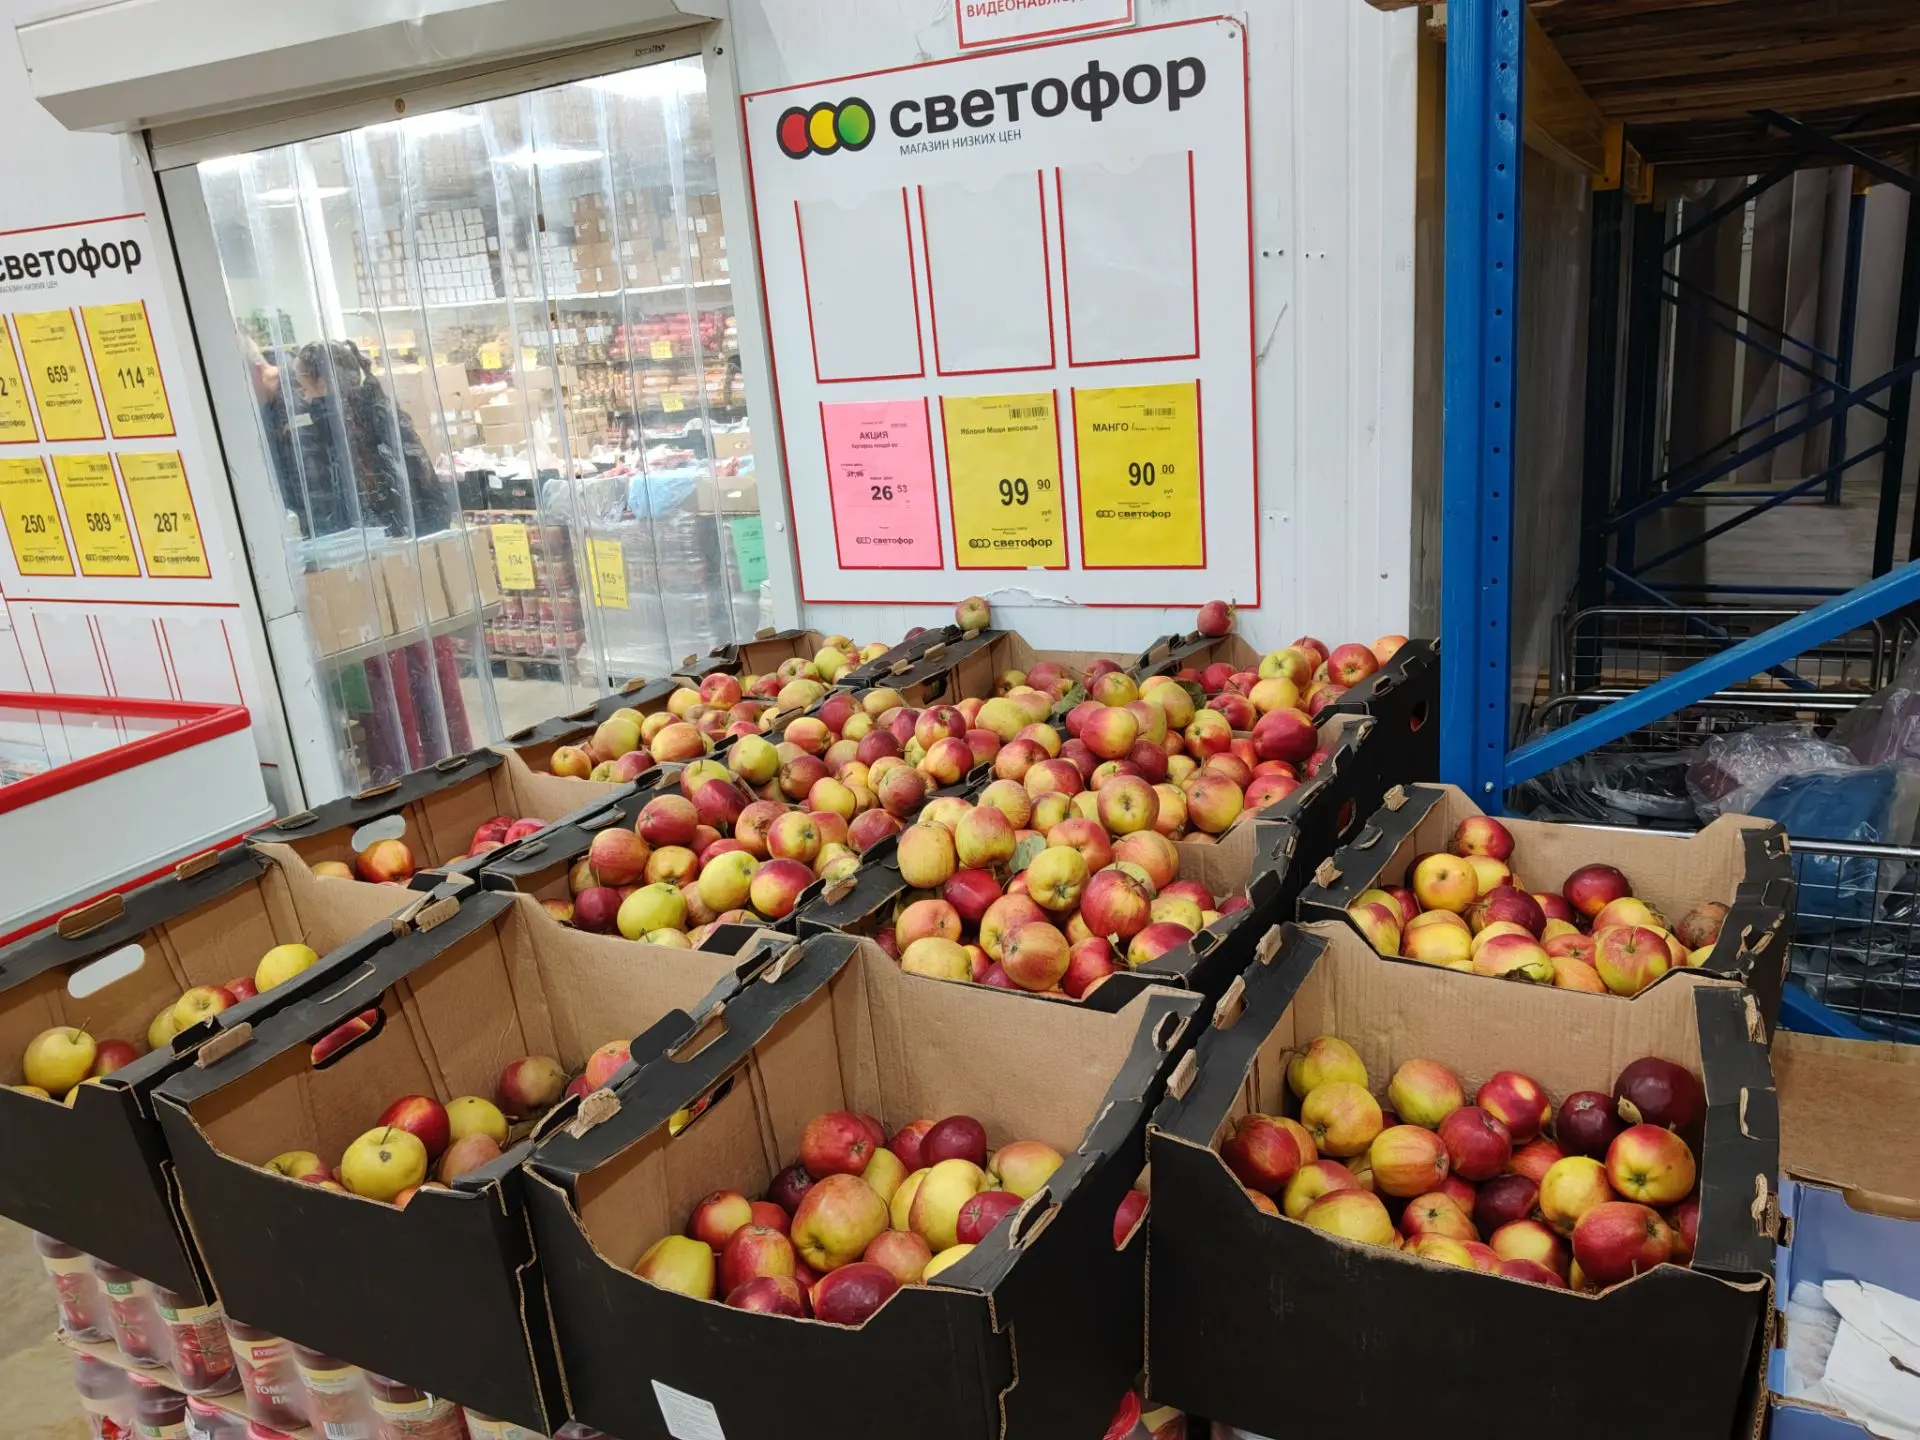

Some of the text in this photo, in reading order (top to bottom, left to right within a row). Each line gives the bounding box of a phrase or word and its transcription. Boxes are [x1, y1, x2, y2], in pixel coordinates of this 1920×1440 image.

[890, 56, 1206, 138] светофор
[900, 128, 1022, 156] МАГАЗИН НИЗКИХ ЦЕН
[46, 365, 69, 384] 659
[117, 366, 145, 390] 114
[859, 430, 889, 441] АКЦИЯ
[1092, 423, 1129, 432] МАНГО
[1128, 462, 1175, 486] 90 00
[870, 485, 908, 500] 26 53
[999, 478, 1051, 506] 99 90
[21, 514, 46, 534] 250
[86, 512, 112, 533] 589
[153, 512, 178, 533] 287
[1117, 510, 1171, 520] светофор
[873, 535, 914, 546] светофор
[993, 538, 1053, 550] светофор
